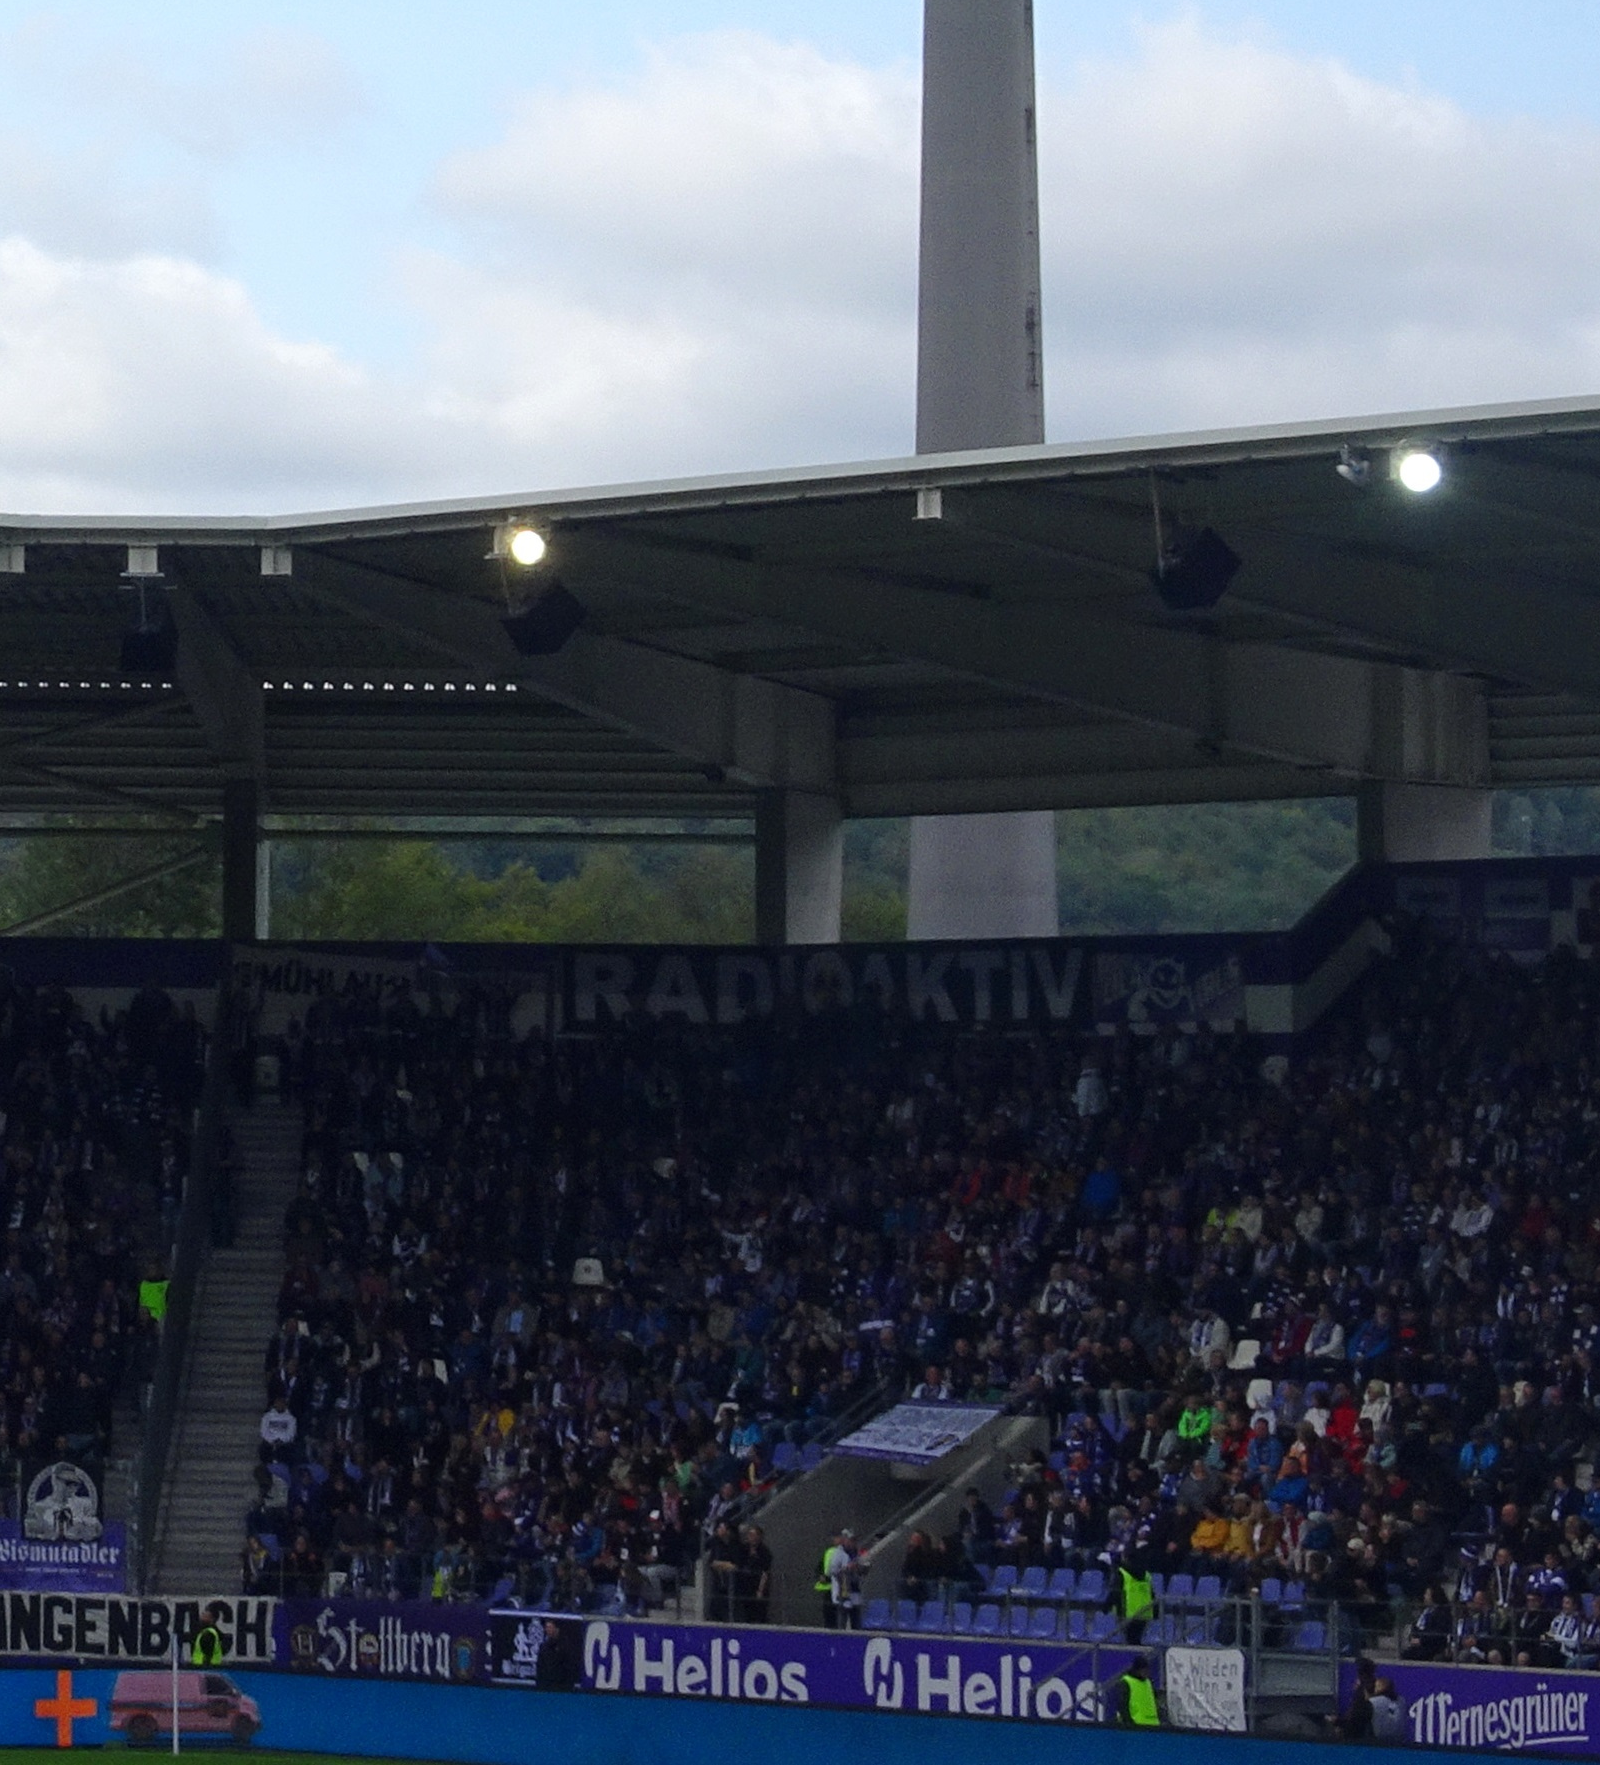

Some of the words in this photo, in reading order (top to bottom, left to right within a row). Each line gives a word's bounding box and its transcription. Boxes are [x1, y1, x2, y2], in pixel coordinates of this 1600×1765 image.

[574, 949, 1083, 1023] RADIOAKTIV
[633, 1632, 809, 1702] Helios
[915, 1652, 1106, 1723] Helios
[1409, 1682, 1589, 1748] Wernesgrüner
